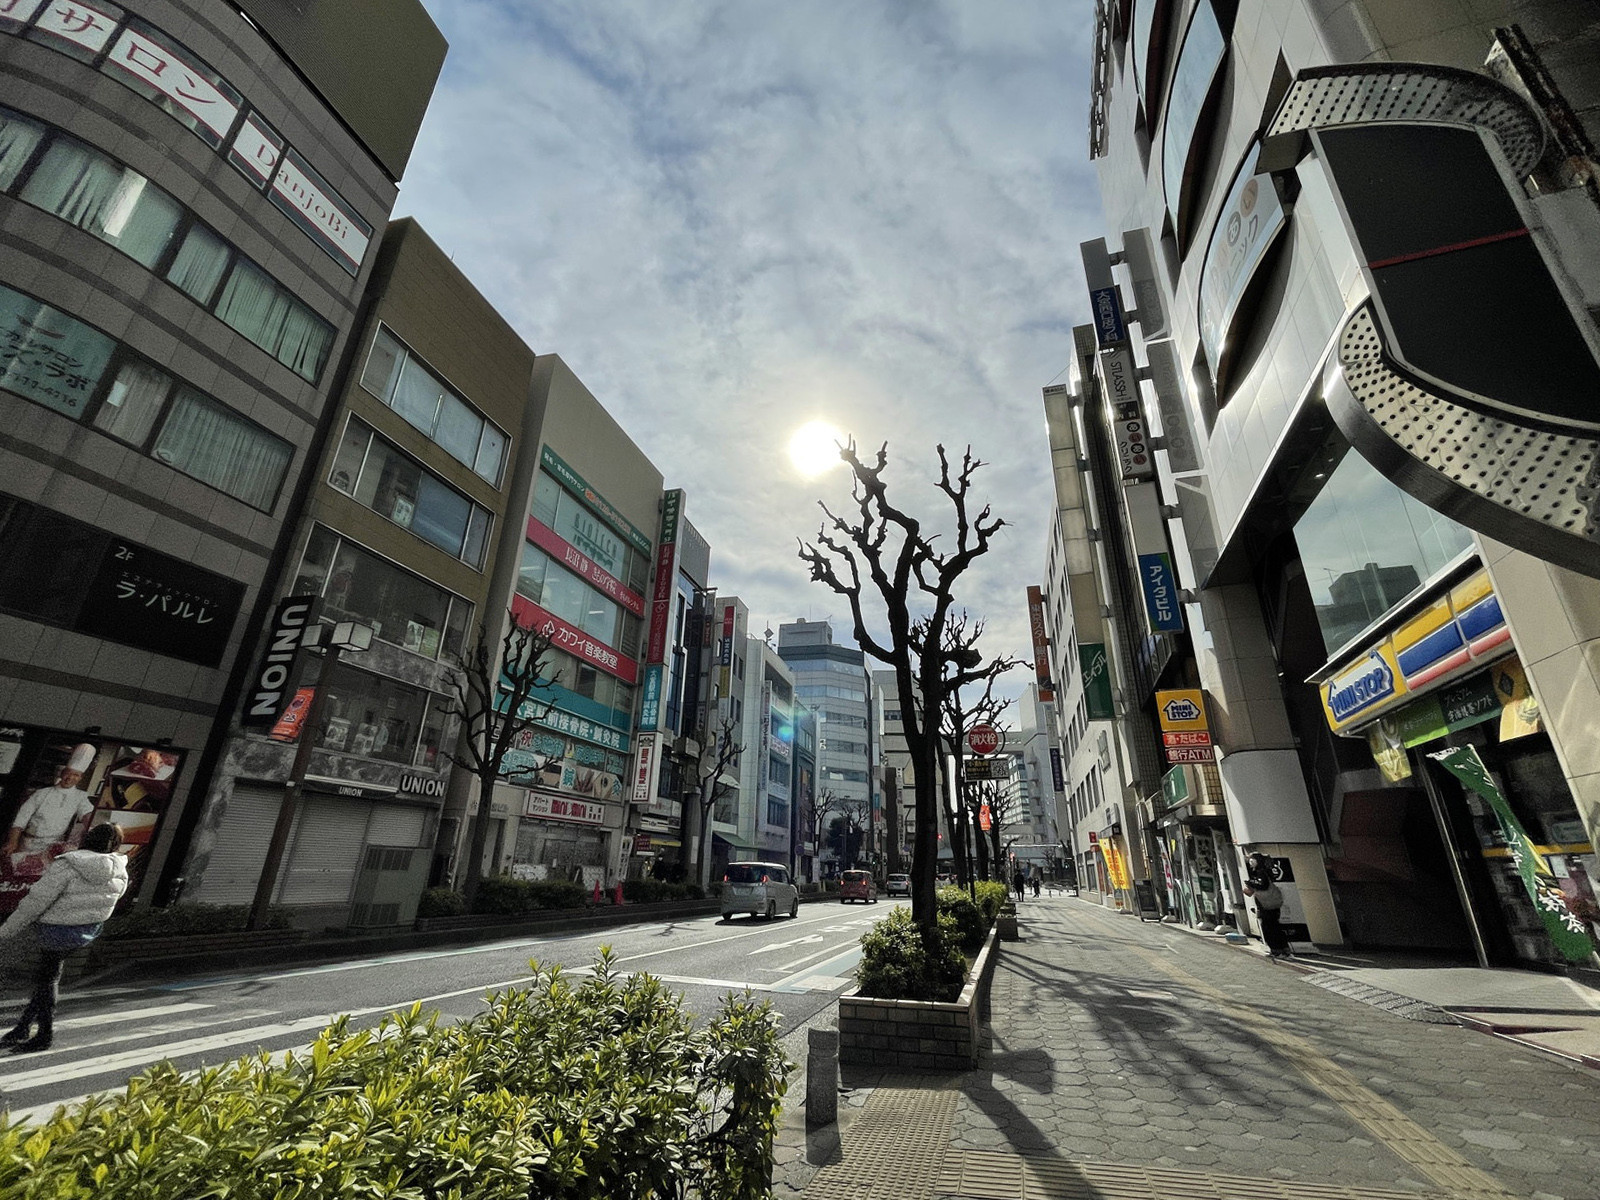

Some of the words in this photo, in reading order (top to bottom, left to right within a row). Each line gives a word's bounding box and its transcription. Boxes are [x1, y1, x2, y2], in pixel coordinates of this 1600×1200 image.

[115, 546, 135, 562] 2F
[116, 580, 213, 624] ラ・パルレ
[558, 627, 618, 670] カワイ音楽教室
[250, 604, 308, 716] UNION
[1083, 655, 1106, 682] エイブル
[515, 701, 621, 749] 宮駅前接骨院・鍼灸院
[970, 733, 996, 746] 消火栓
[1166, 733, 1209, 745] 酒・たばこ
[1168, 749, 1212, 761] 銀行ATM
[338, 785, 363, 797] UNION
[401, 775, 446, 797] UNION
